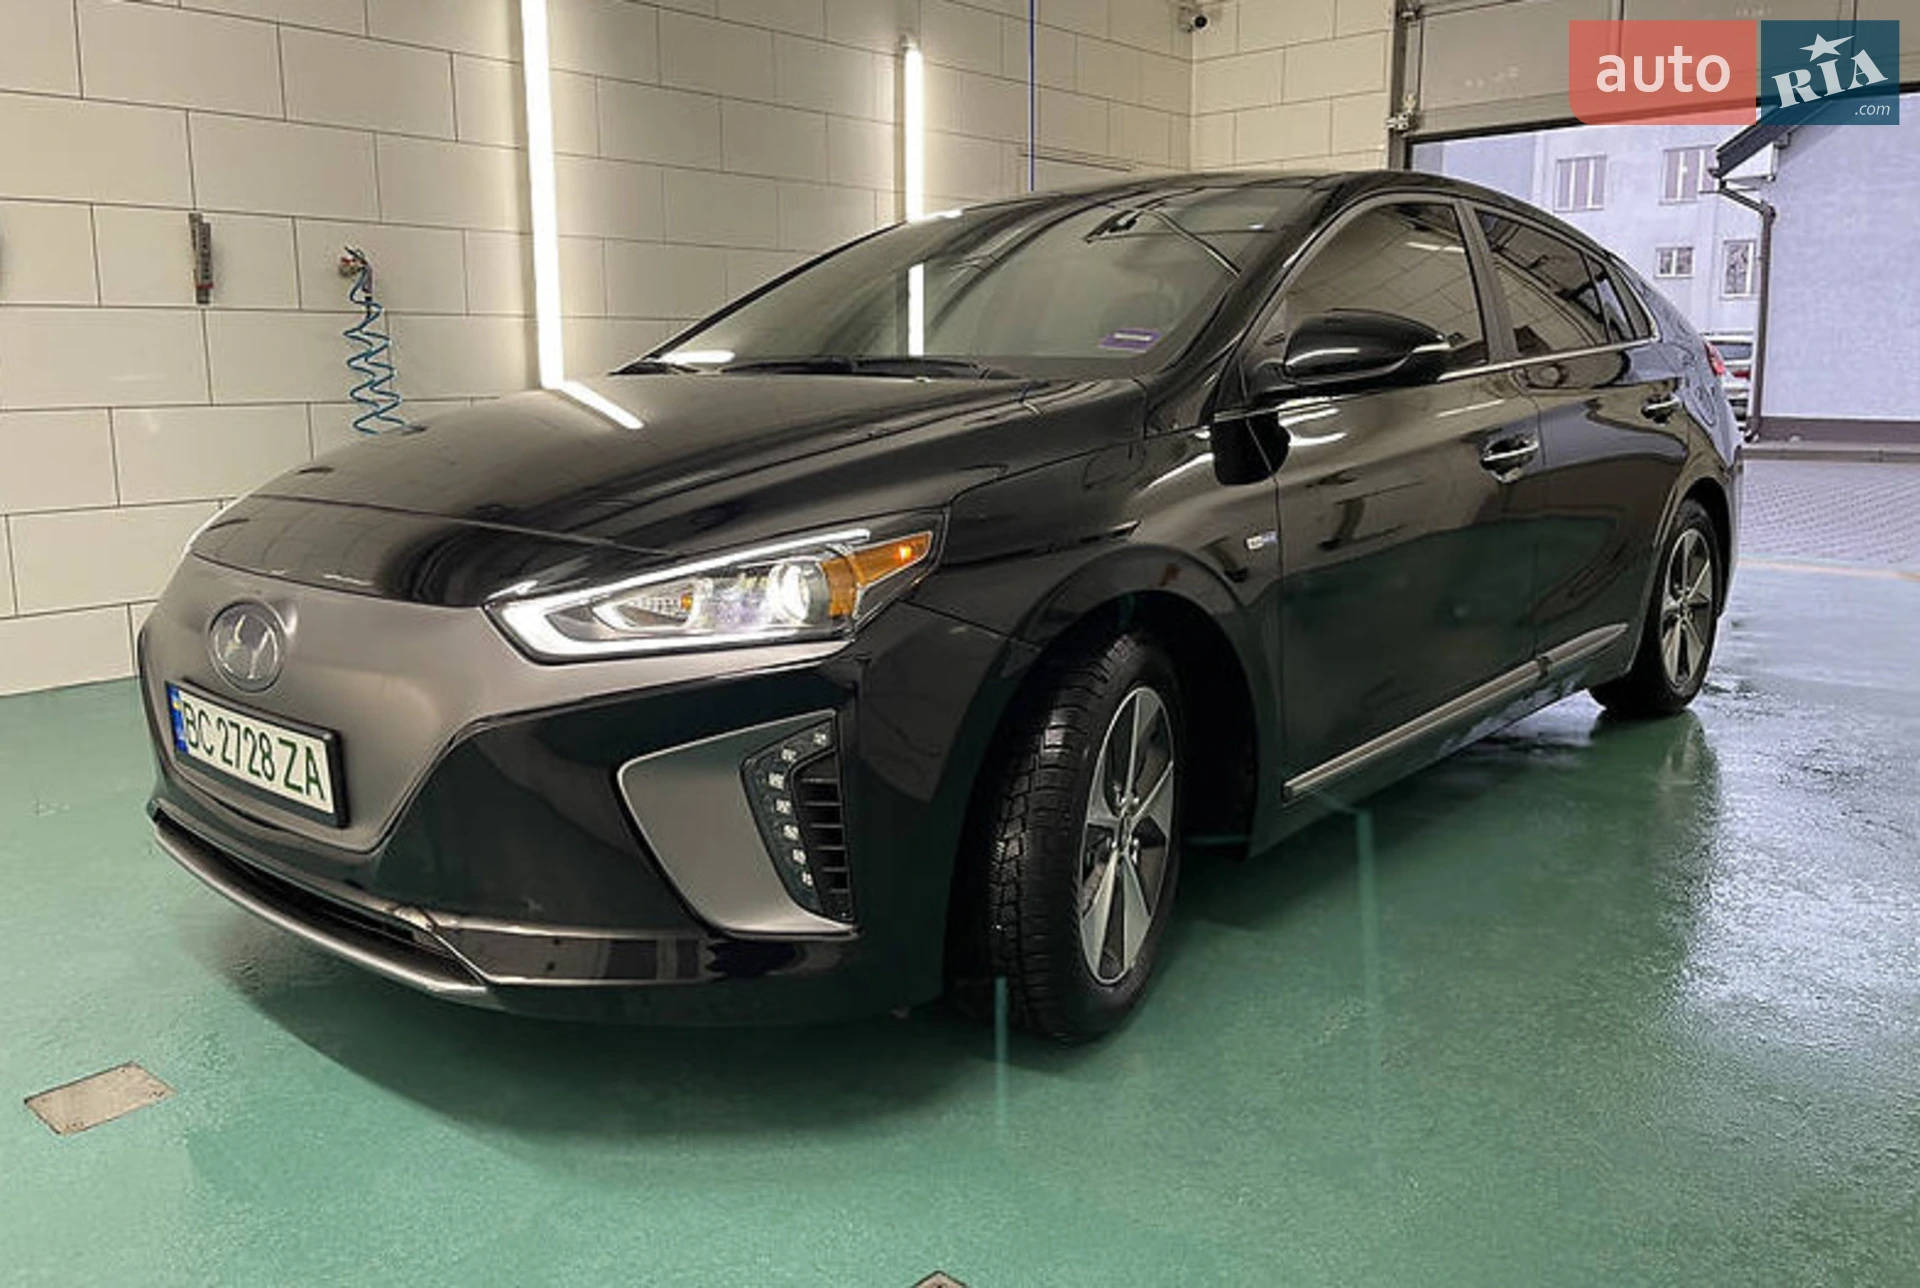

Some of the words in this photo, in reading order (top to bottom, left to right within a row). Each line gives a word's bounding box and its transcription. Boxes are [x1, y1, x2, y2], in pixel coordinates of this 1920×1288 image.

[183, 701, 214, 755] BC
[217, 717, 275, 782] 2728
[278, 737, 326, 801] ZA
